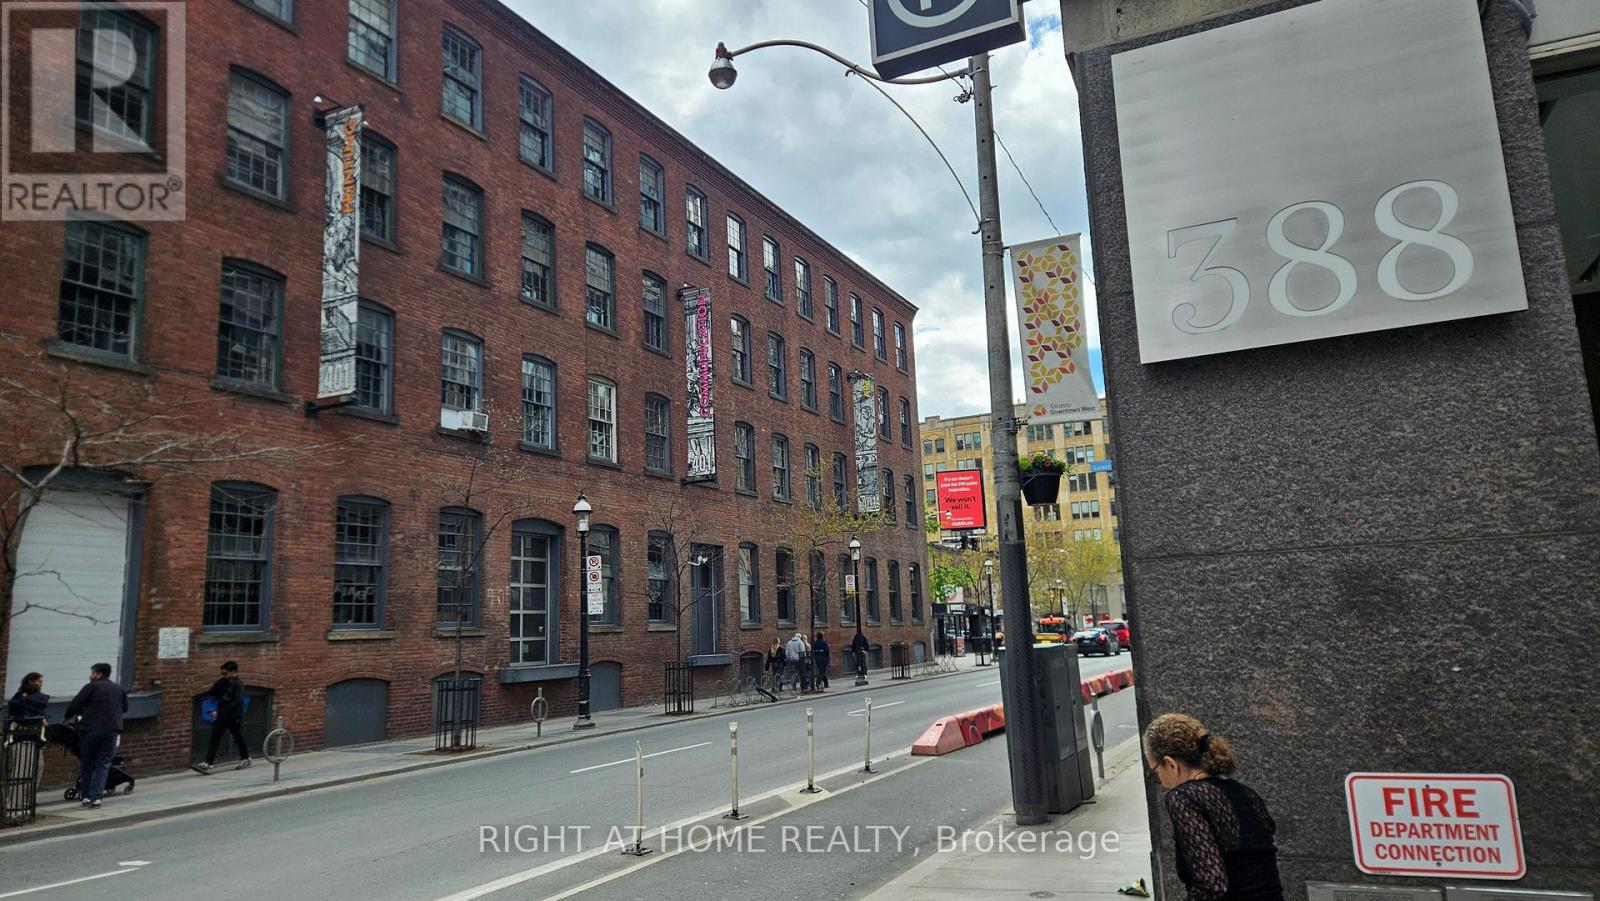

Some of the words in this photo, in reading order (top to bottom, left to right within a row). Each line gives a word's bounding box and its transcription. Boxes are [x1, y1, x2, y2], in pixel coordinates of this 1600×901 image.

[1167, 179, 1474, 335] 388
[1050, 407, 1081, 415] Downtown
[692, 454, 711, 472] 401
[957, 495, 976, 503] won't
[1382, 787, 1480, 818] FIRE
[1370, 821, 1500, 841] DEPARTMENT
[1375, 843, 1501, 864] CONNECTION
